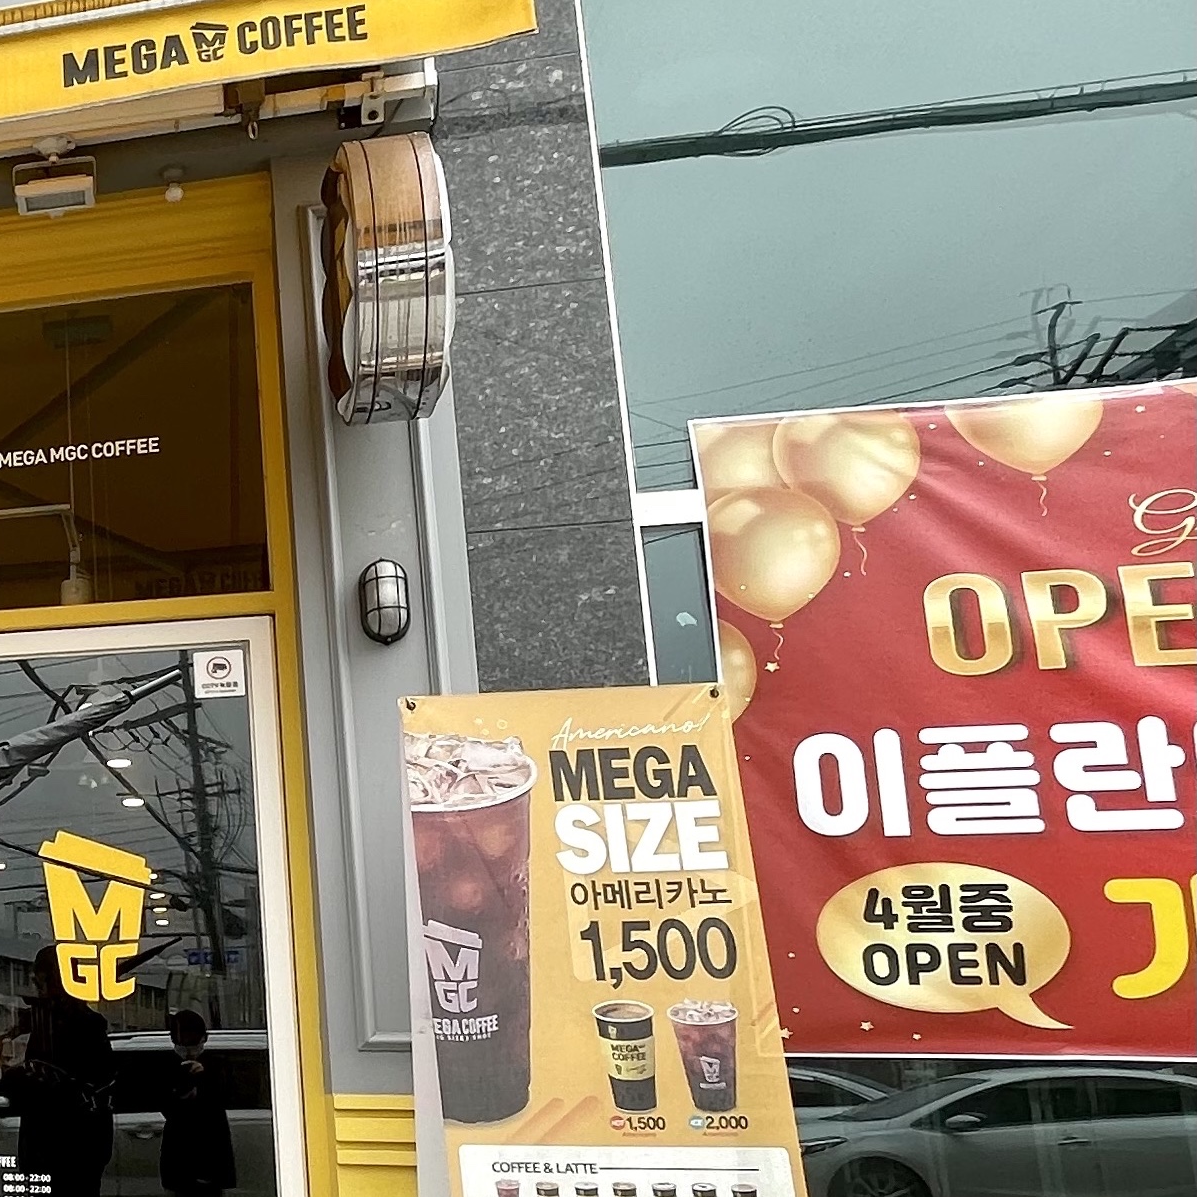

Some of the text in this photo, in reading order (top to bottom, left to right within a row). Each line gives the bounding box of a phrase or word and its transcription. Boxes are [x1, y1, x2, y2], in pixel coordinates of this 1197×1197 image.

[62, 4, 368, 88] MEGA COFFEE
[49, 444, 89, 463] MGC
[91, 436, 160, 459] COFFEE
[548, 743, 718, 802] MEGA
[791, 713, 1197, 838] 이플란
[554, 799, 730, 876] SIZE
[570, 877, 733, 911] 아메리카노
[862, 882, 1014, 934] 4월중
[579, 916, 739, 990] 1,500
[862, 941, 1027, 987] OPEN
[431, 1017, 462, 1035] EGA
[626, 1115, 666, 1132] 1,500
[705, 1115, 749, 1131] 2,000
[29, 1174, 52, 1183] 22:00
[491, 1161, 599, 1174] COFFEE & LATTE
[29, 1185, 52, 1194] 22:00
